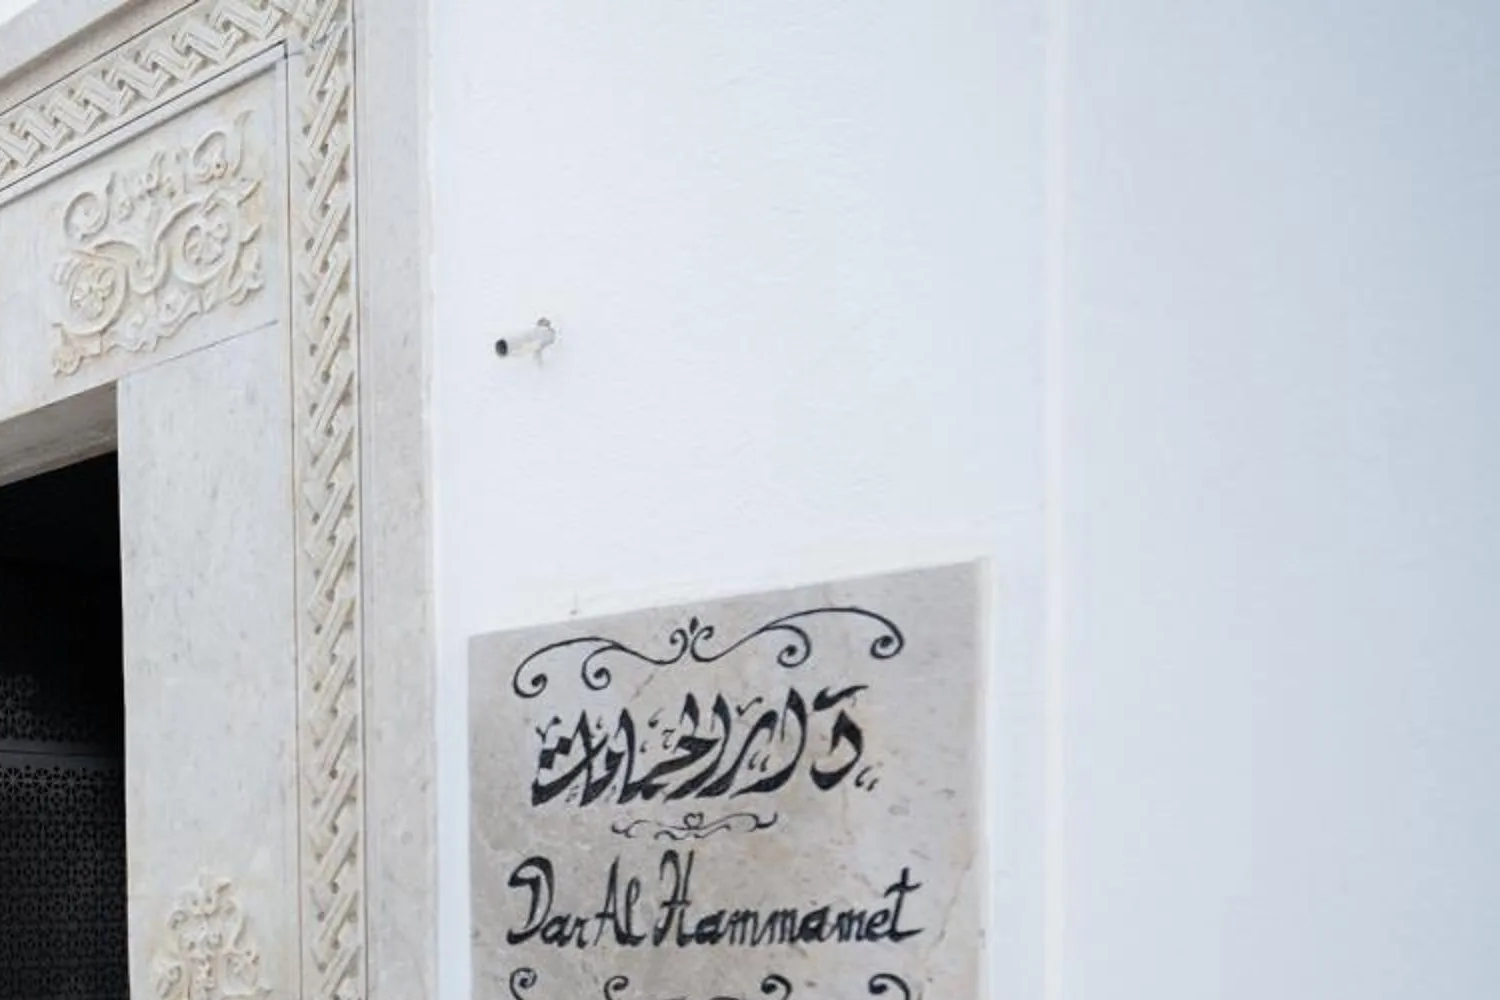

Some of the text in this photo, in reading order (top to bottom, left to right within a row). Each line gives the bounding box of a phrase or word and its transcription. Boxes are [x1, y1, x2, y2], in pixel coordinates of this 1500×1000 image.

[506, 848, 927, 949] Dar Al Hammamet
